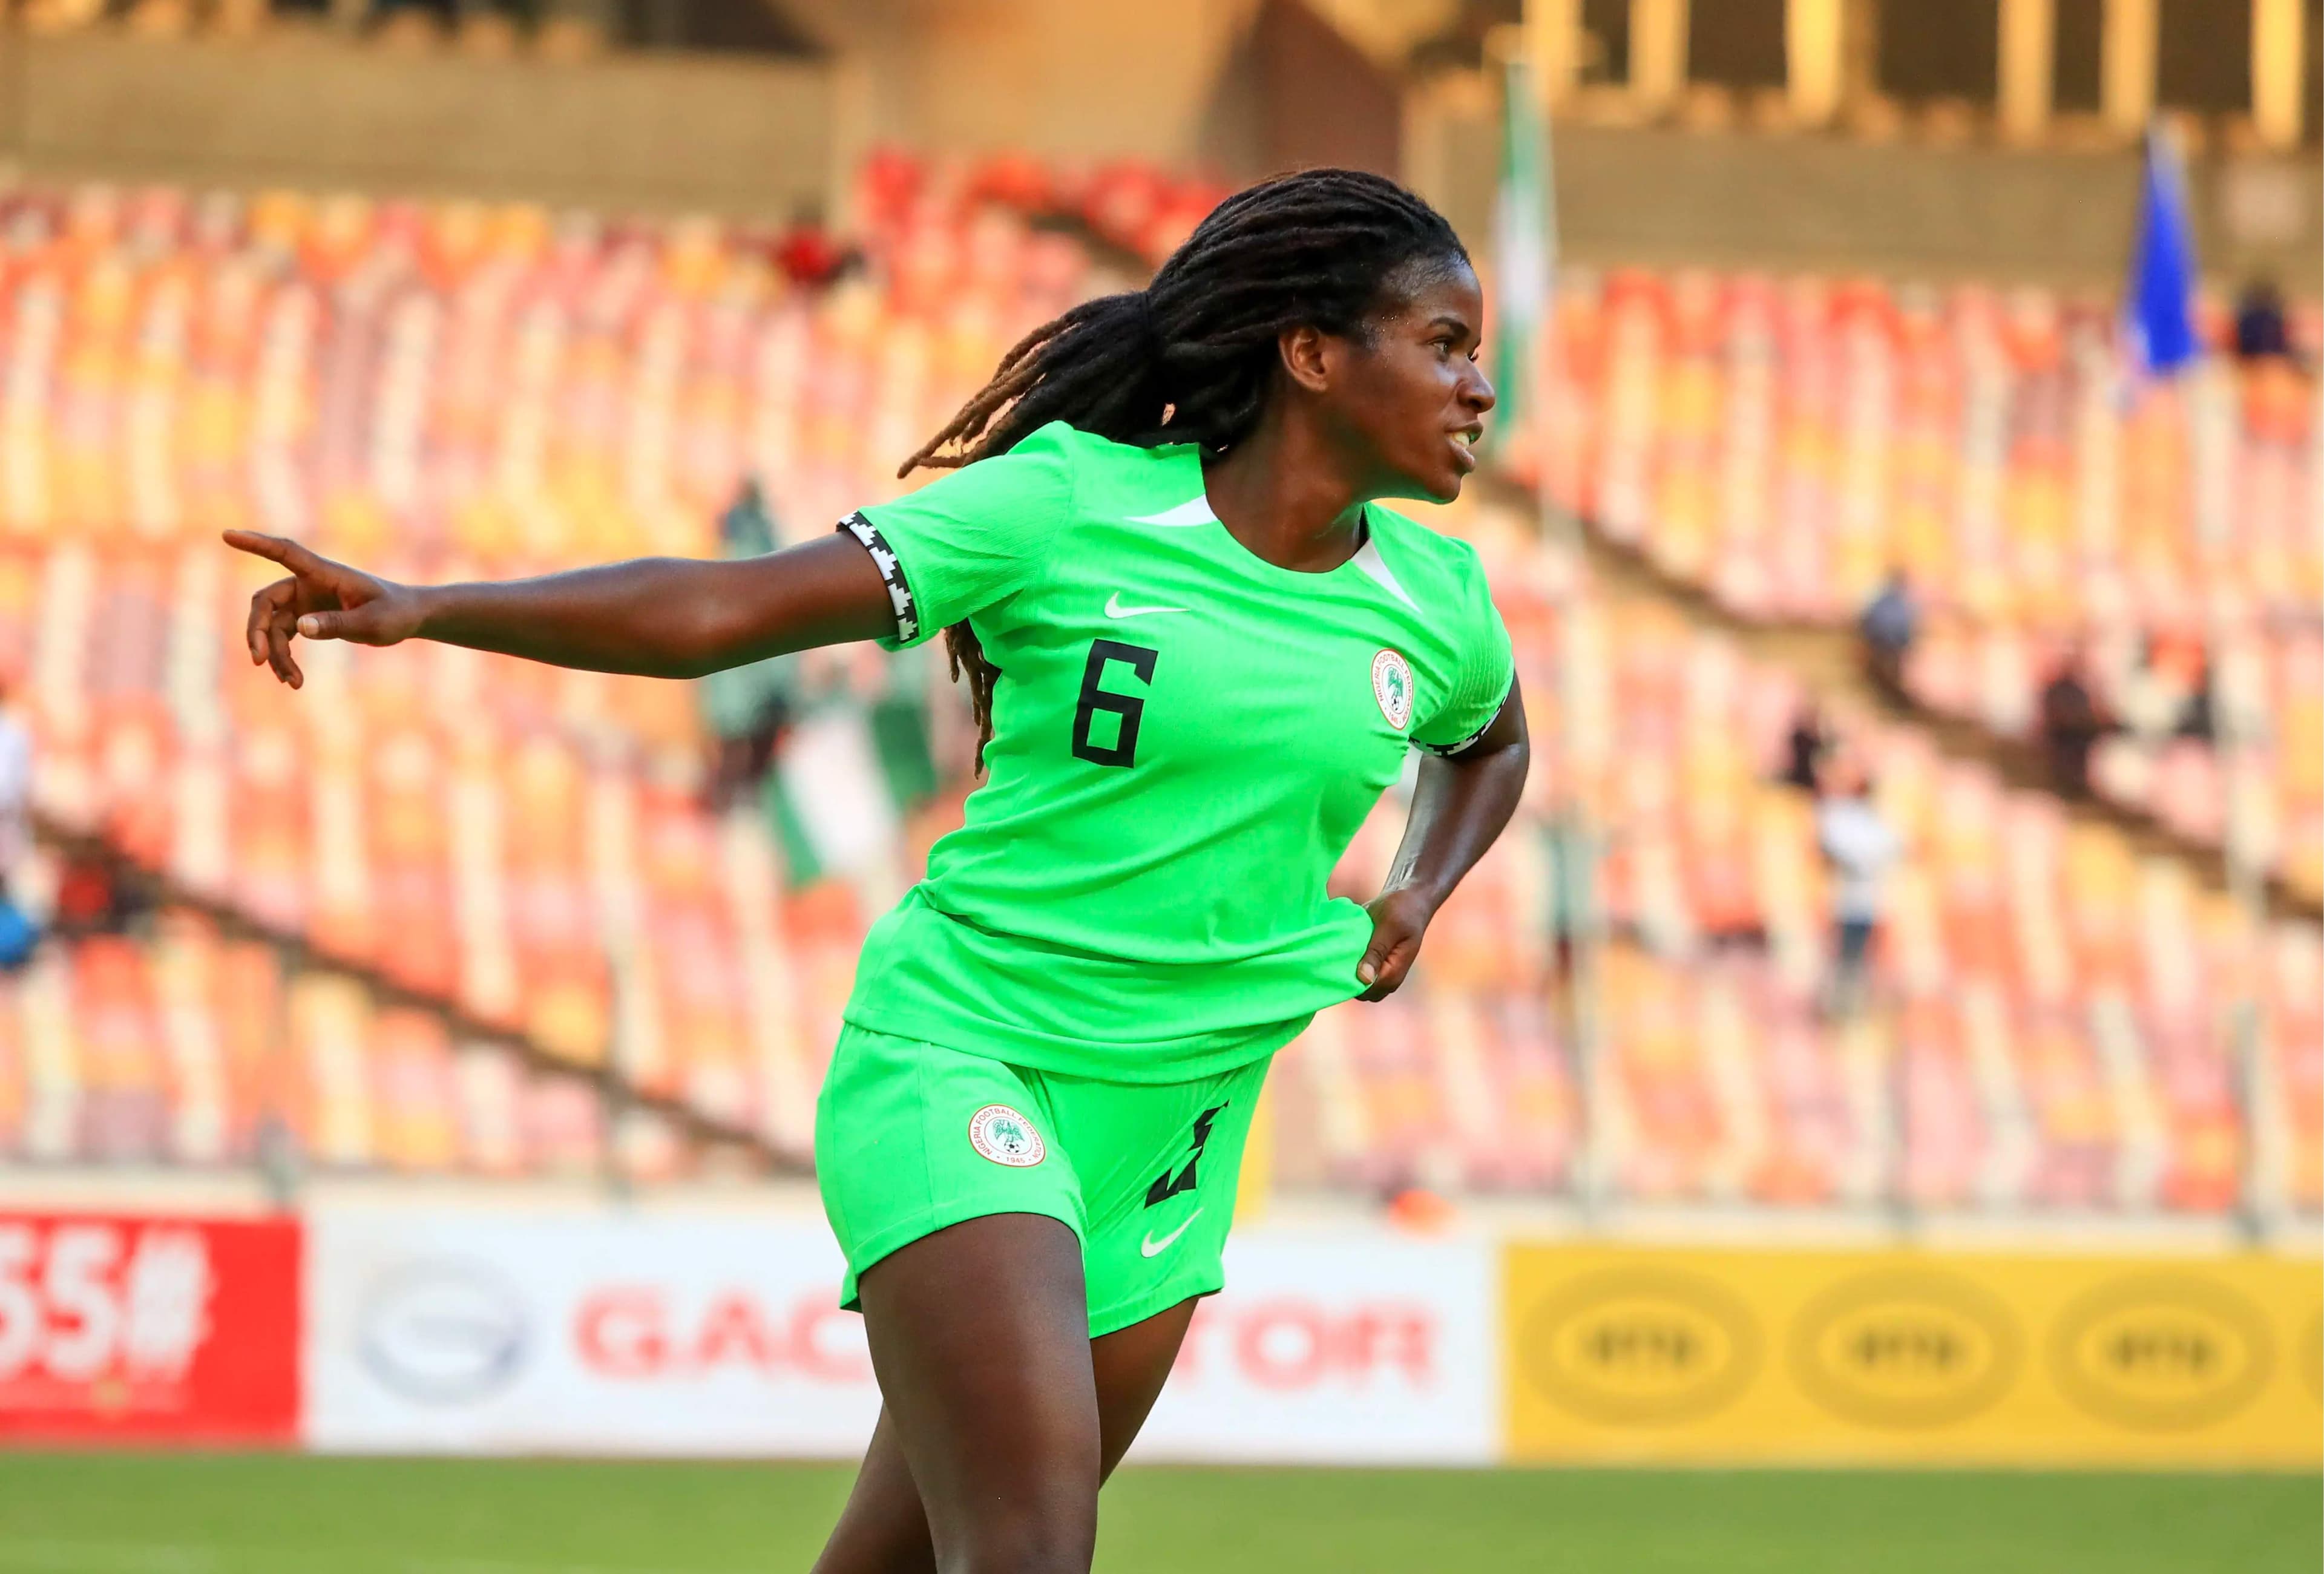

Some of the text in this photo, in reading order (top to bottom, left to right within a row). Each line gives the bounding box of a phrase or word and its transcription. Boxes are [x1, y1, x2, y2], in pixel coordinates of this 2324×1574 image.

[1377, 654, 1405, 671] FOOTBALL
[1071, 638, 1158, 769] 6
[976, 1108, 1017, 1126] FOOTBALL
[973, 1126, 993, 1155] NIGERIA
